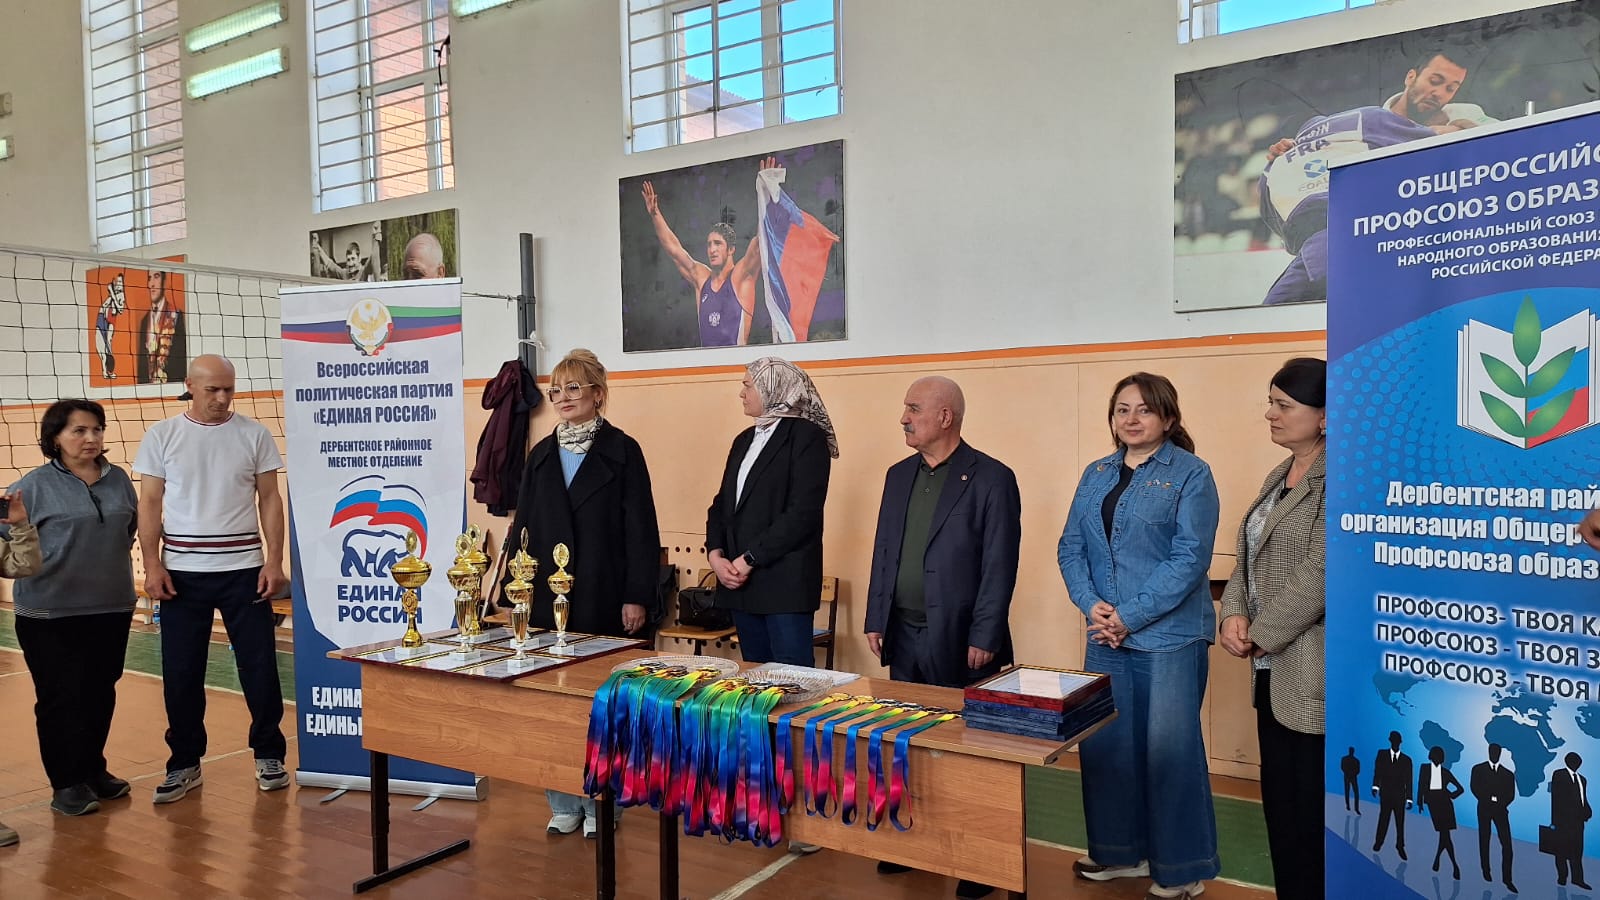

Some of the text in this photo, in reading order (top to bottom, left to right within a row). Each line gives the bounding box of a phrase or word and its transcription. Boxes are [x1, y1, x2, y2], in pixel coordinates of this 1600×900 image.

[1285, 139, 1330, 163] FRA
[1353, 178, 1599, 236] ПРОФСОЮЗ ОБРАЗ
[1377, 210, 1595, 253] ПРОФЕССИОНАЛЬНЫЙ СОЮЗ
[1397, 244, 1485, 267] НАРОДНОГО
[1431, 254, 1534, 279] РОССИЙСКОЙ
[317, 358, 429, 379] Всероссийская
[295, 383, 453, 402] политическая партия
[313, 405, 437, 426] «ЕДИНАЯ РОССИЯ»
[320, 437, 432, 454] ДЕРБЕНТСКОЕ РАЙОННОЕ
[328, 455, 423, 469] МЕСТНОЕ ОТДЕЛЕНИЕ
[1386, 481, 1600, 511] Дербентская рай
[1340, 512, 1588, 546] организация Общер
[1374, 541, 1599, 580] Профсоюза образ
[1511, 608, 1574, 634] ТВОЯ
[1582, 615, 1600, 637] К
[1376, 624, 1498, 656] ПРОФСОЮЗ
[1516, 641, 1579, 667] ТВОЯ
[1384, 653, 1507, 688] ПРОФСОЮЗ
[1526, 673, 1590, 701] ТВОЯ
